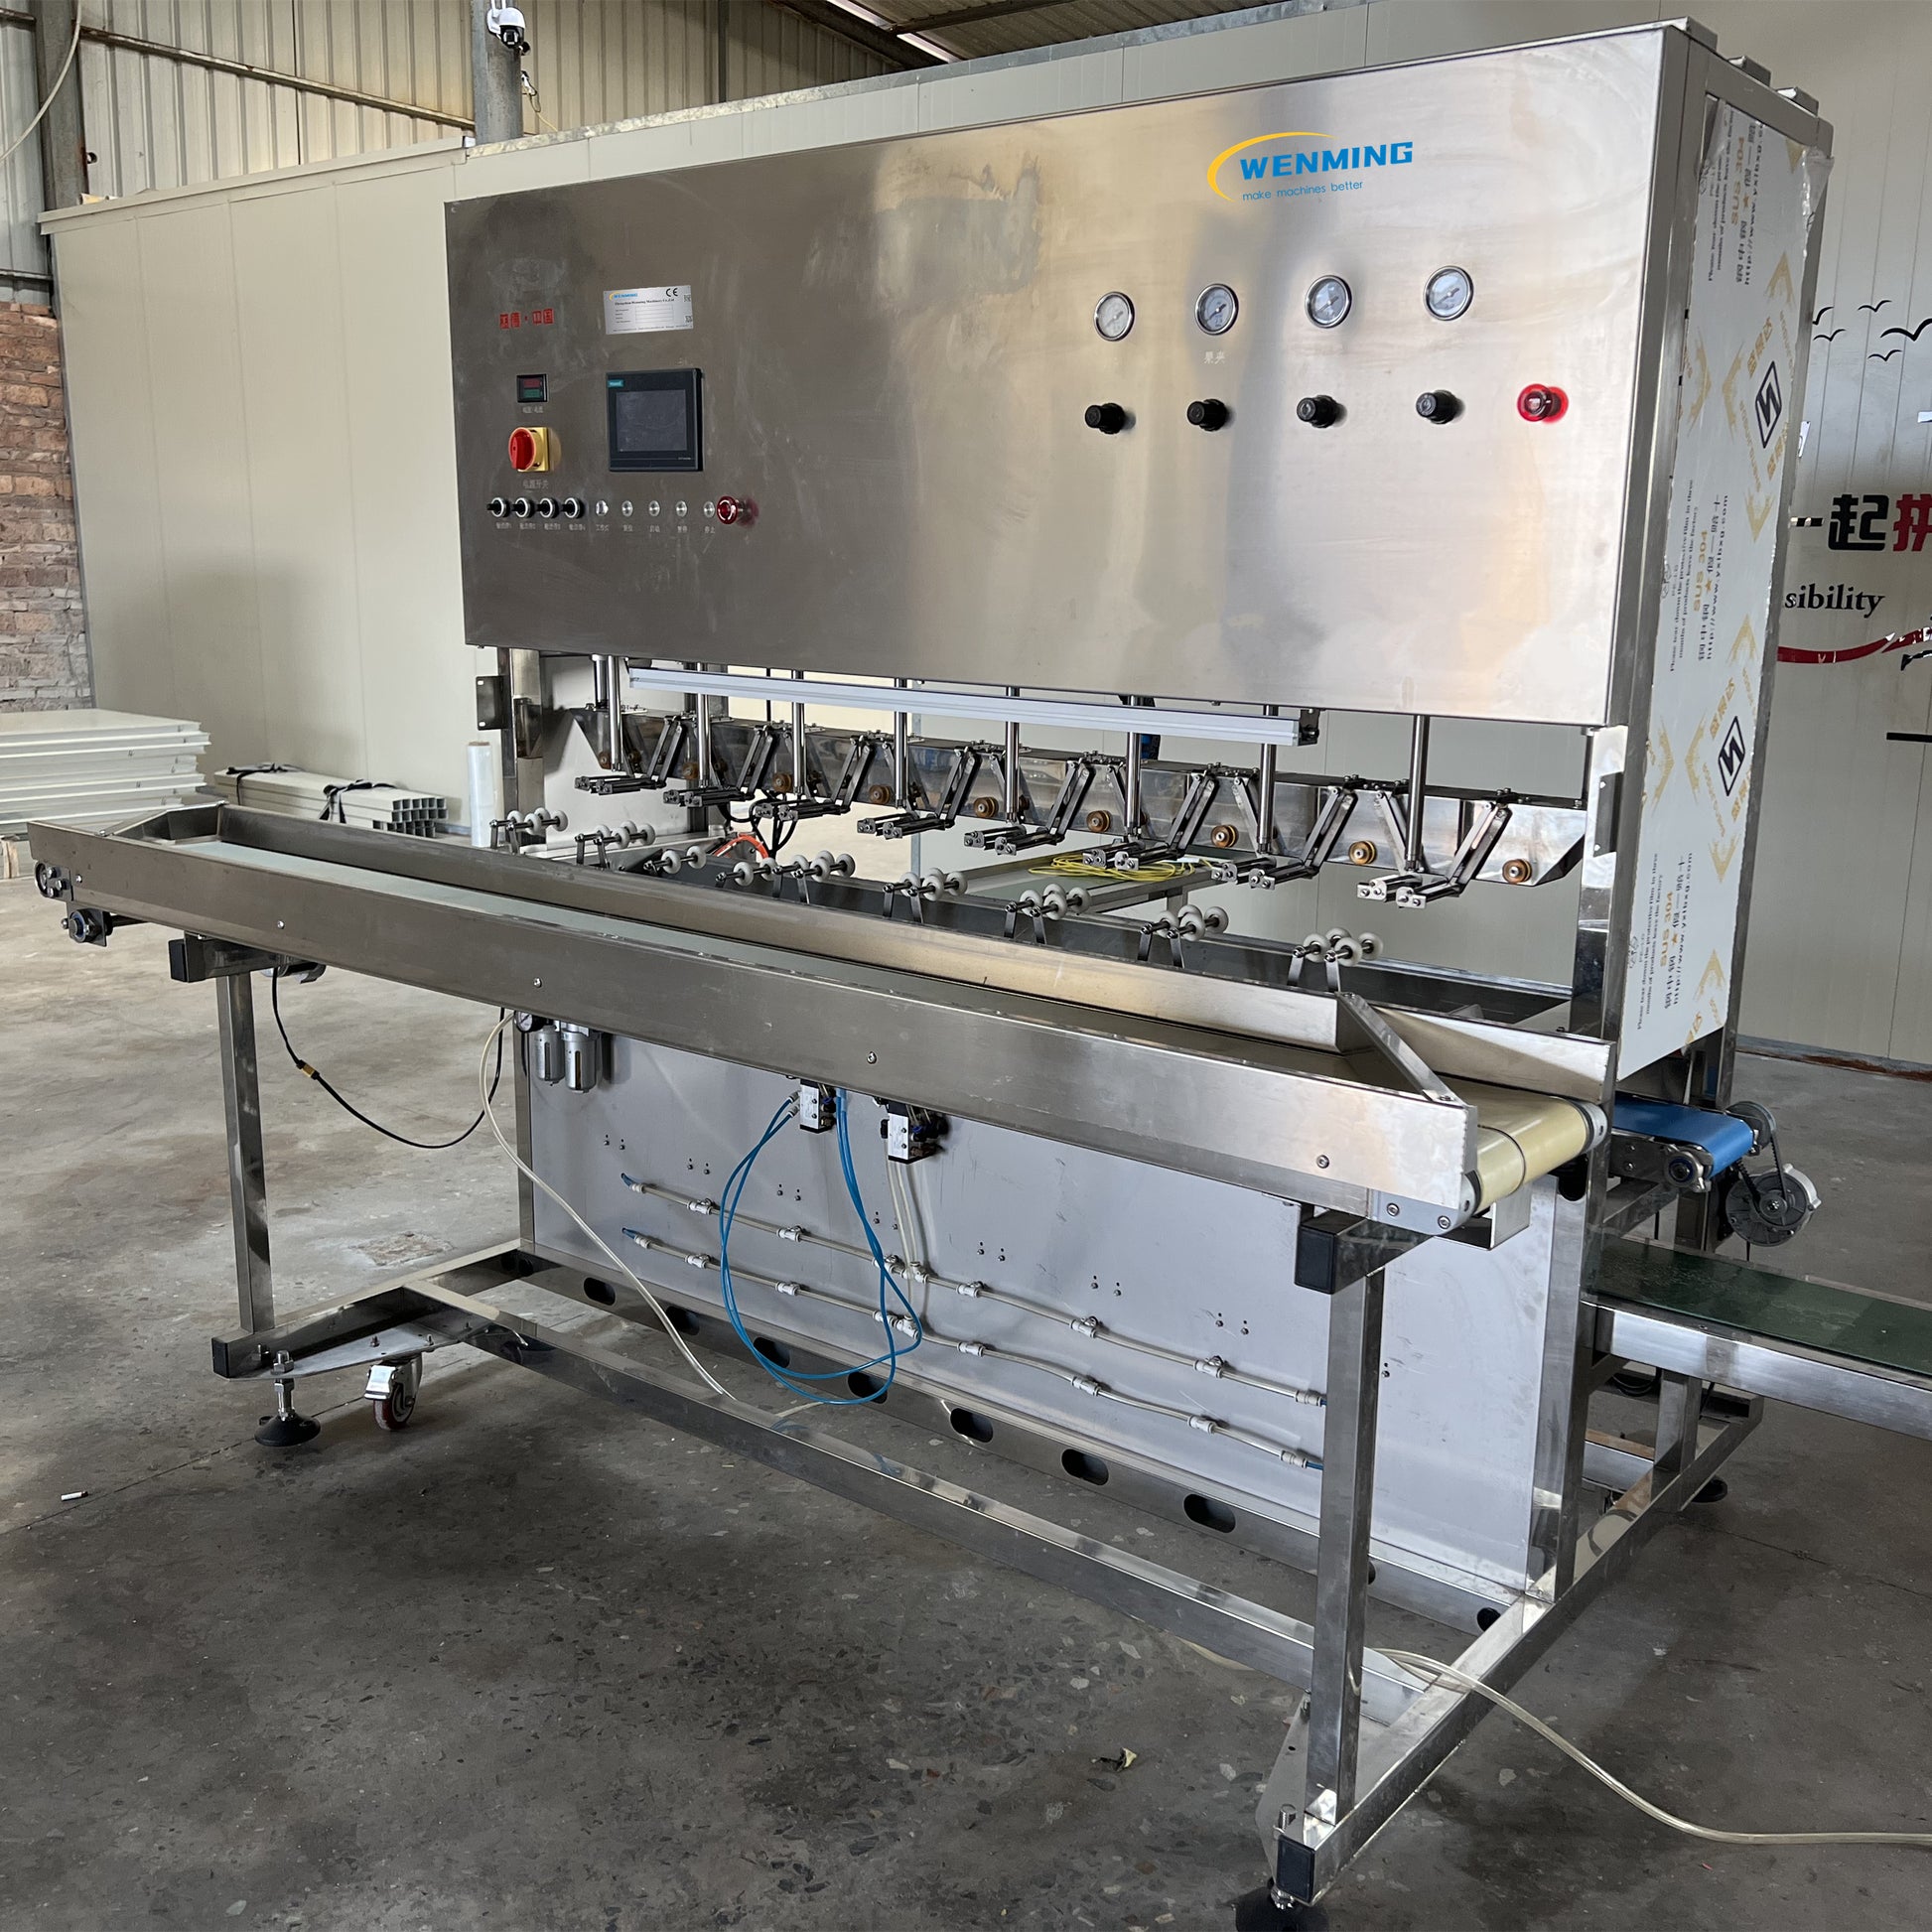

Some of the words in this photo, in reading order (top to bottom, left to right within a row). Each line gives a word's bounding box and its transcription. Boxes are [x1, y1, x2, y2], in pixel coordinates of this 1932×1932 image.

[1240, 141, 1414, 180] WENMING
[1735, 137, 1744, 173] 304
[1242, 190, 1272, 202] make
[1277, 184, 1326, 198] machines
[1330, 180, 1364, 192] better
[1731, 182, 1740, 225] SUS
[1694, 571, 1704, 612] SUS
[1699, 531, 1708, 563] 304
[1784, 583, 1885, 619] sibility
[1660, 929, 1669, 966] SUS
